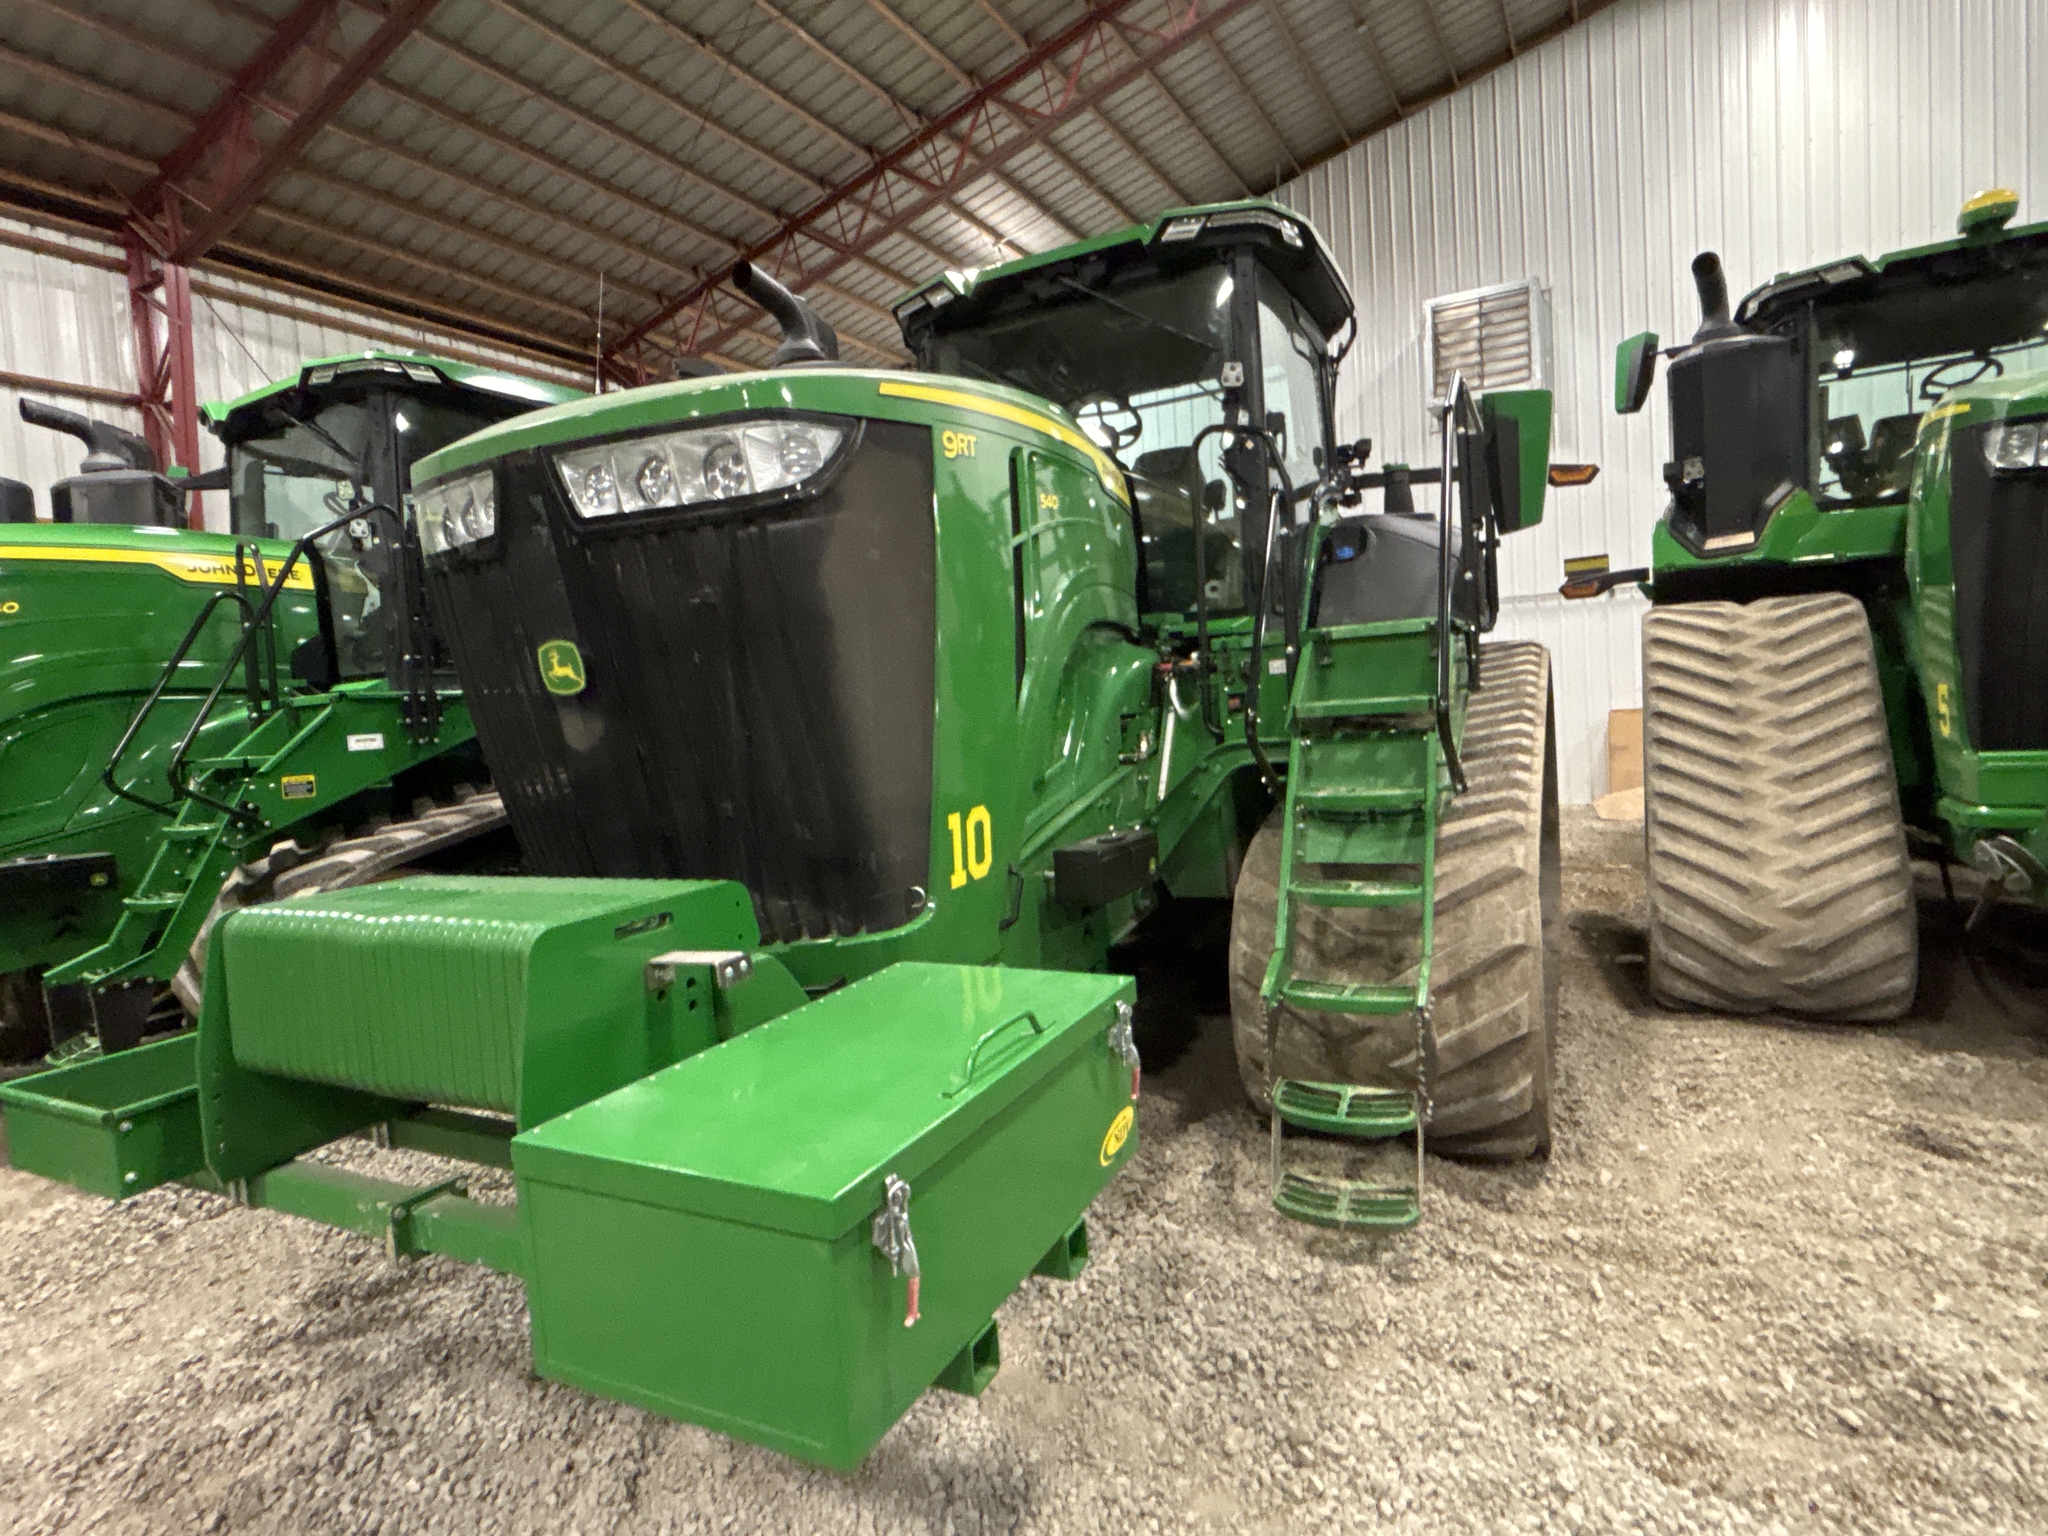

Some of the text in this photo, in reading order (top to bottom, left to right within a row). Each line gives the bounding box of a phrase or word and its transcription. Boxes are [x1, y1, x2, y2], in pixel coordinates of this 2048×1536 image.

[942, 430, 977, 458] 9RT
[243, 564, 302, 580] DEE
[0, 602, 19, 613] 0
[1937, 684, 1950, 737] 5
[948, 805, 992, 889] 10
